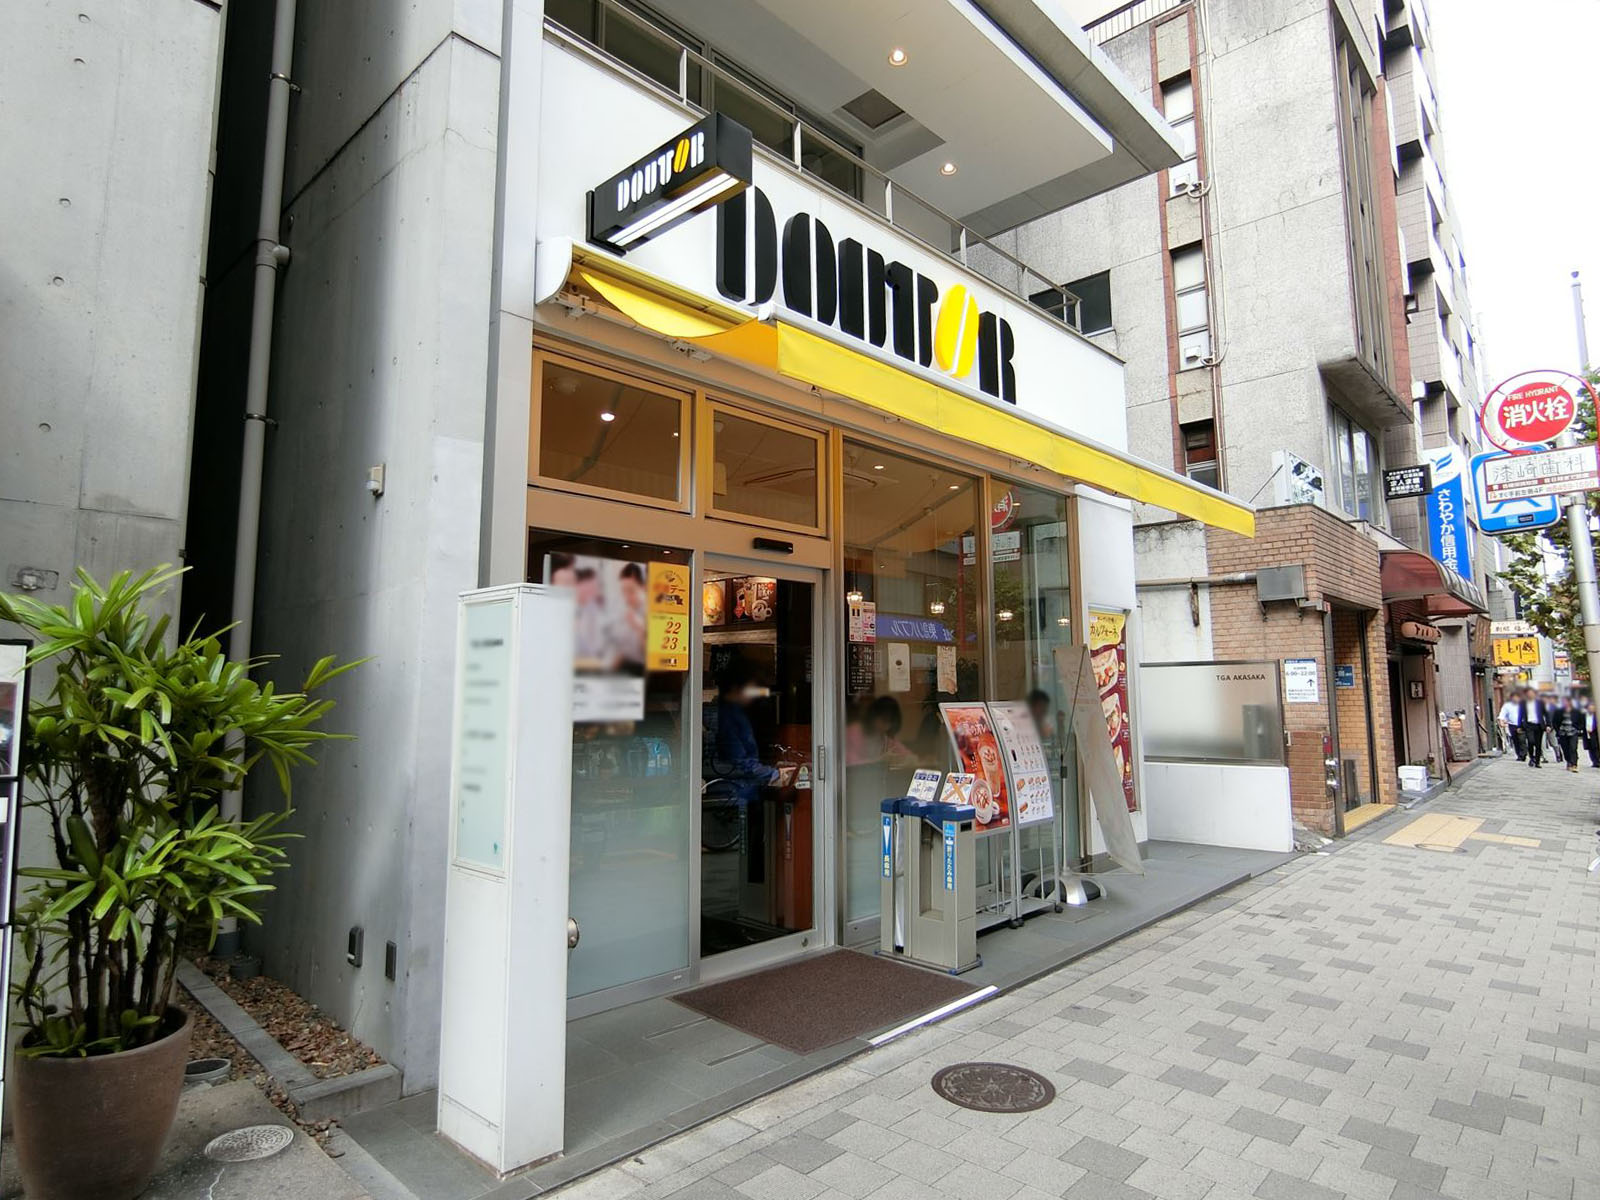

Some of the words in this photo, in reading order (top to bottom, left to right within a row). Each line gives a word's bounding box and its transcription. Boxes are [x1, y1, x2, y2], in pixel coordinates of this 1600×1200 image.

[617, 131, 705, 212] DOUTOR
[716, 186, 1017, 404] DOUTOR
[1507, 392, 1524, 402] FIRE
[1525, 385, 1559, 398] HYDRANT
[1503, 395, 1570, 429] 消火栓
[1437, 488, 1459, 573] さわやか信用金
[664, 621, 682, 635] 22
[661, 636, 678, 650] 23
[1233, 673, 1266, 681] AKASAKA
